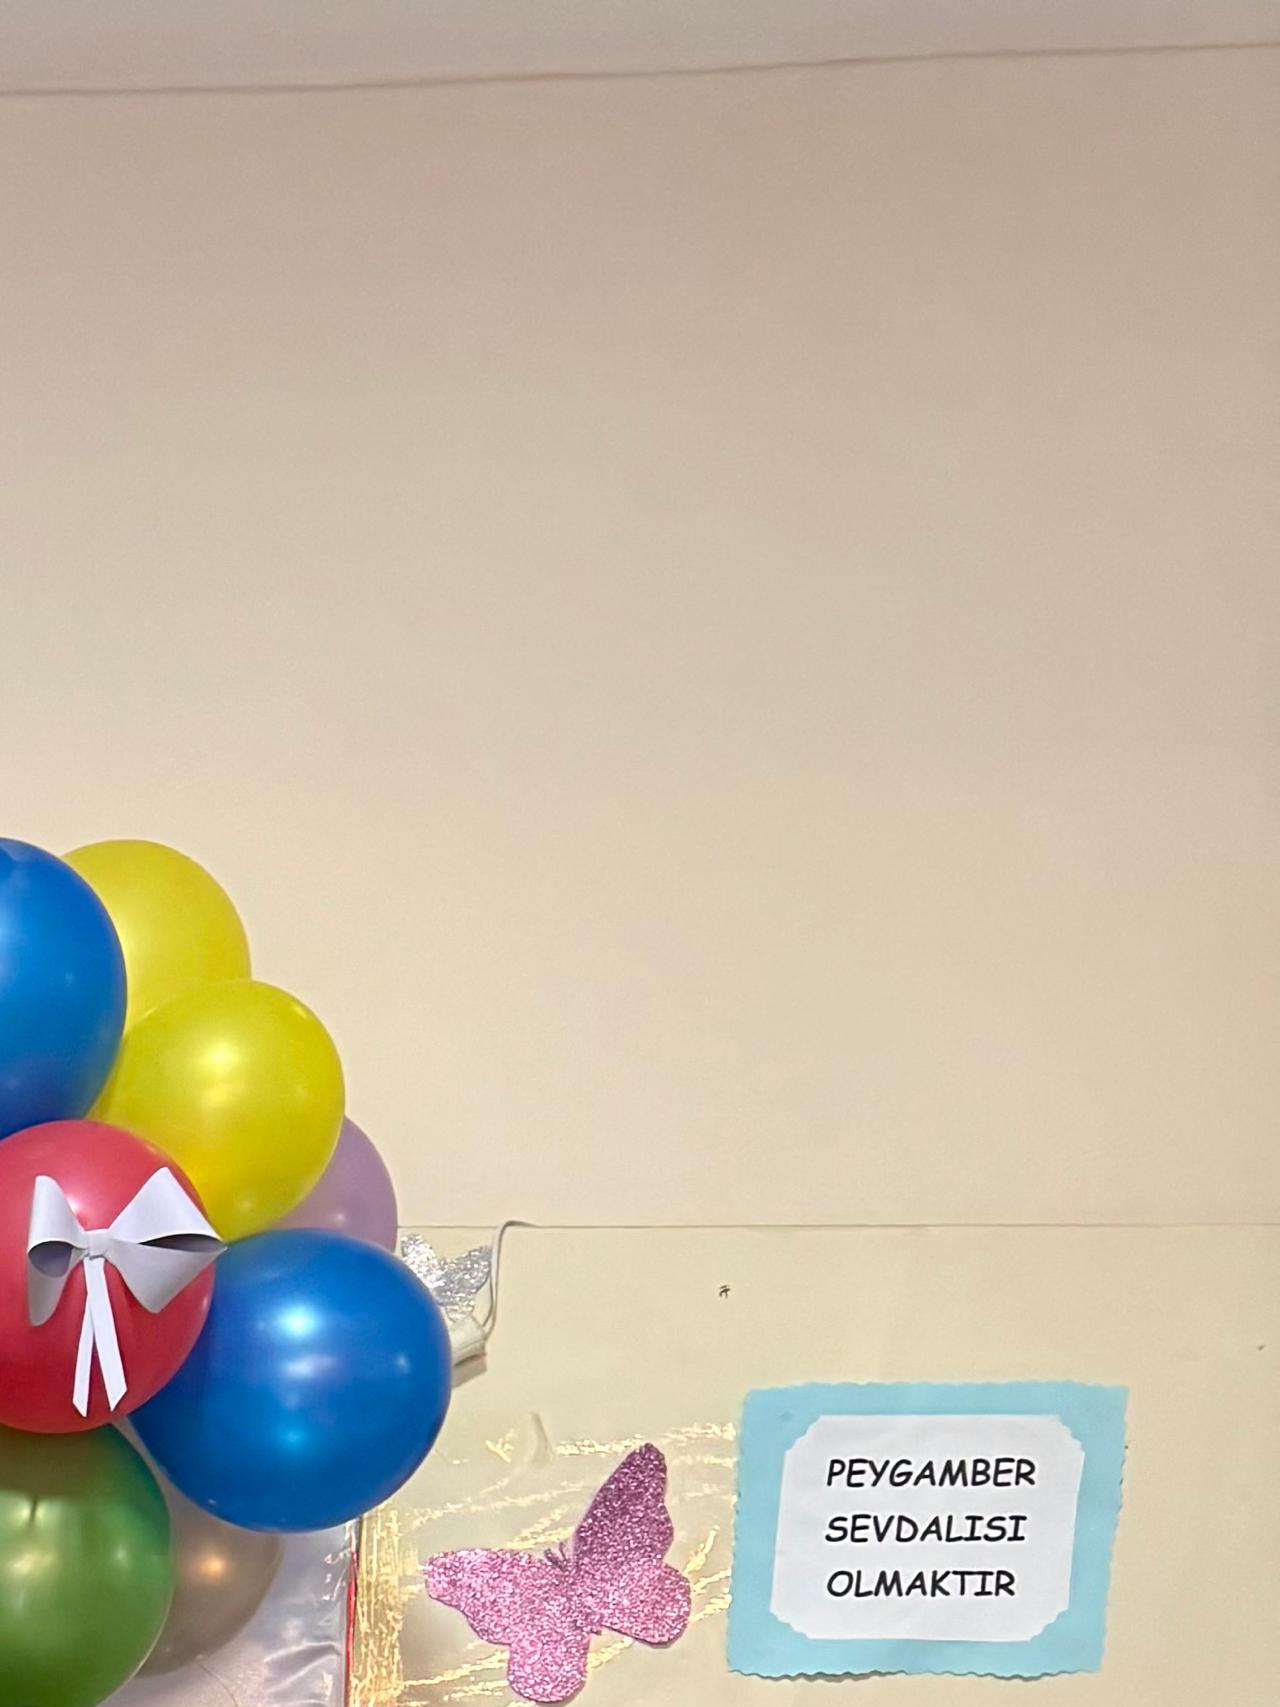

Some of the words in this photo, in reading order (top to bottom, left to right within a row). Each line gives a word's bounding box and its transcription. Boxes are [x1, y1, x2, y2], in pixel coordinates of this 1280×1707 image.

[825, 1456, 1037, 1490] PEYGAMBER
[824, 1512, 1029, 1544] SEVDALISI
[825, 1569, 1017, 1599] OLMAKTIR
